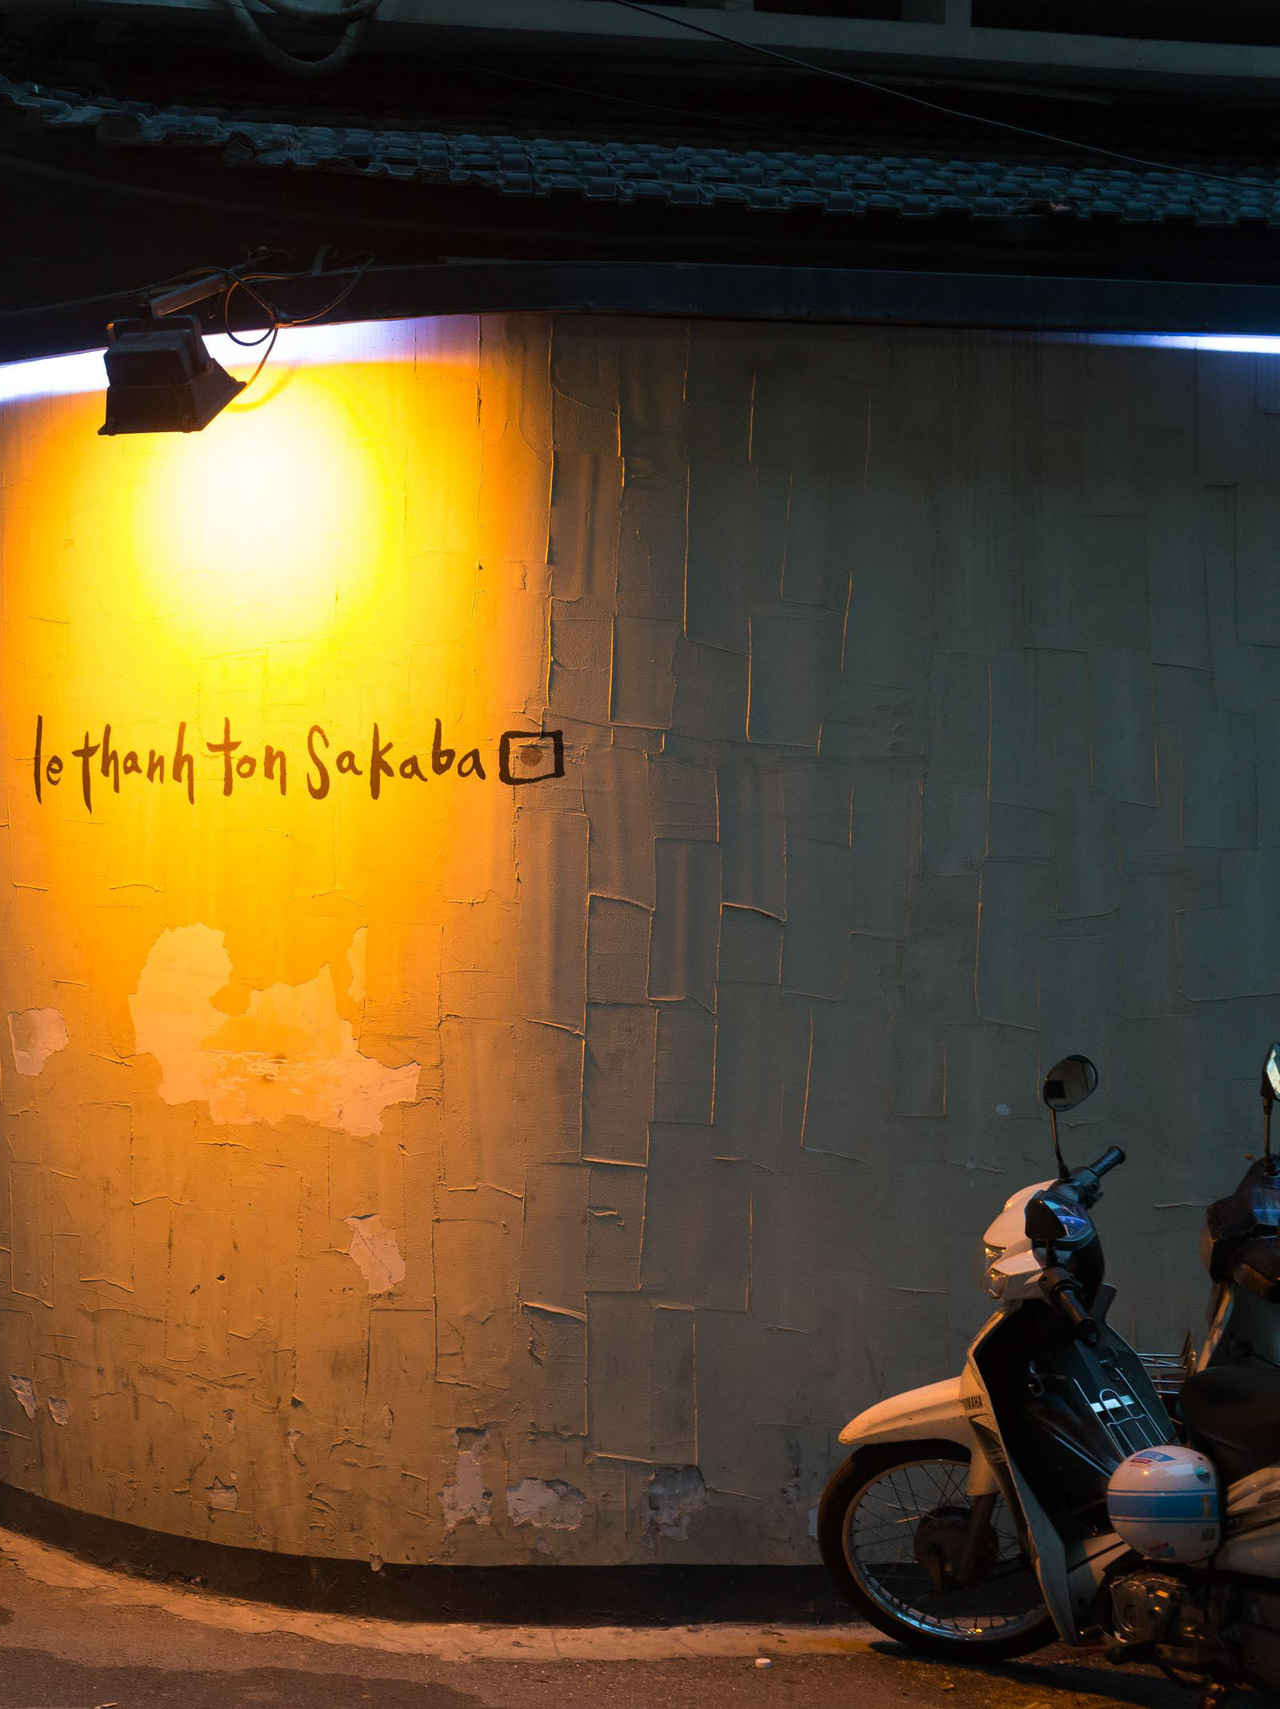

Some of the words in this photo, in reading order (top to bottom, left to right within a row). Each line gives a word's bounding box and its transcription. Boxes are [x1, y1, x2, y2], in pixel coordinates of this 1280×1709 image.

[34, 714, 63, 804] le
[71, 722, 195, 814] thanh
[206, 716, 287, 796] ton
[305, 718, 487, 800] Sakaba
